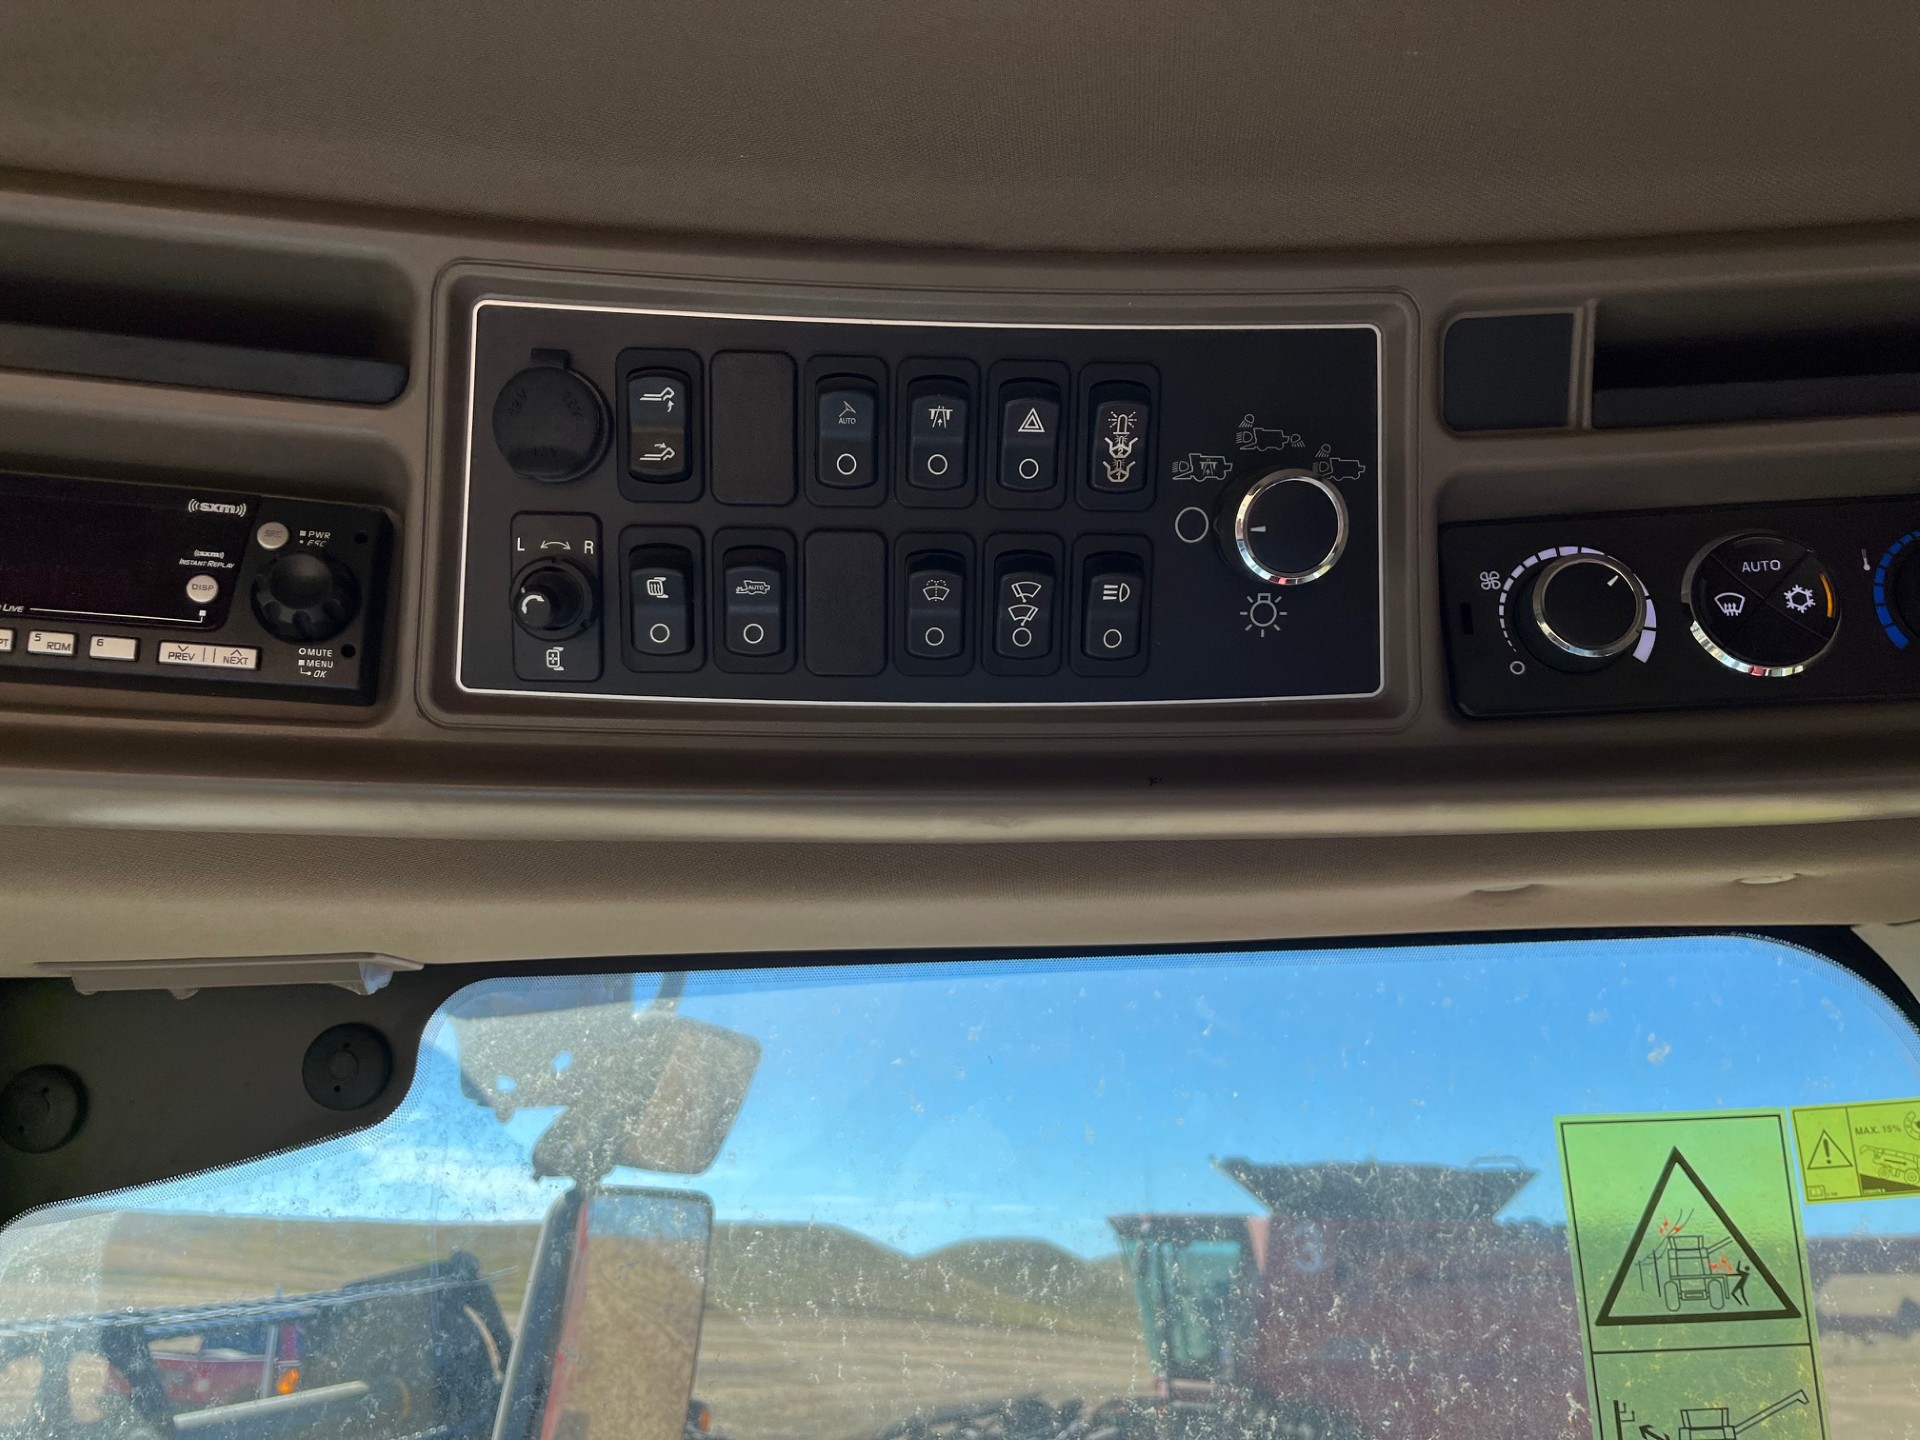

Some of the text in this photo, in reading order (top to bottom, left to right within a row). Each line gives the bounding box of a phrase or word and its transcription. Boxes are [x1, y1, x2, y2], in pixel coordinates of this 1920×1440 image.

[838, 417, 857, 425] AUTO
[308, 530, 331, 539] PWR
[517, 537, 526, 551] L
[584, 540, 594, 554] R
[1741, 559, 1781, 573] AUTO
[191, 583, 215, 592] DISP
[34, 633, 72, 651] 5 RDM
[96, 638, 104, 647] 6
[168, 652, 196, 662] PREV
[306, 648, 333, 657] MUTE
[223, 656, 249, 666] NEXT
[306, 659, 334, 669] MENU
[313, 670, 328, 679] OK
[1855, 1124, 1902, 1135] MAX. 15%
